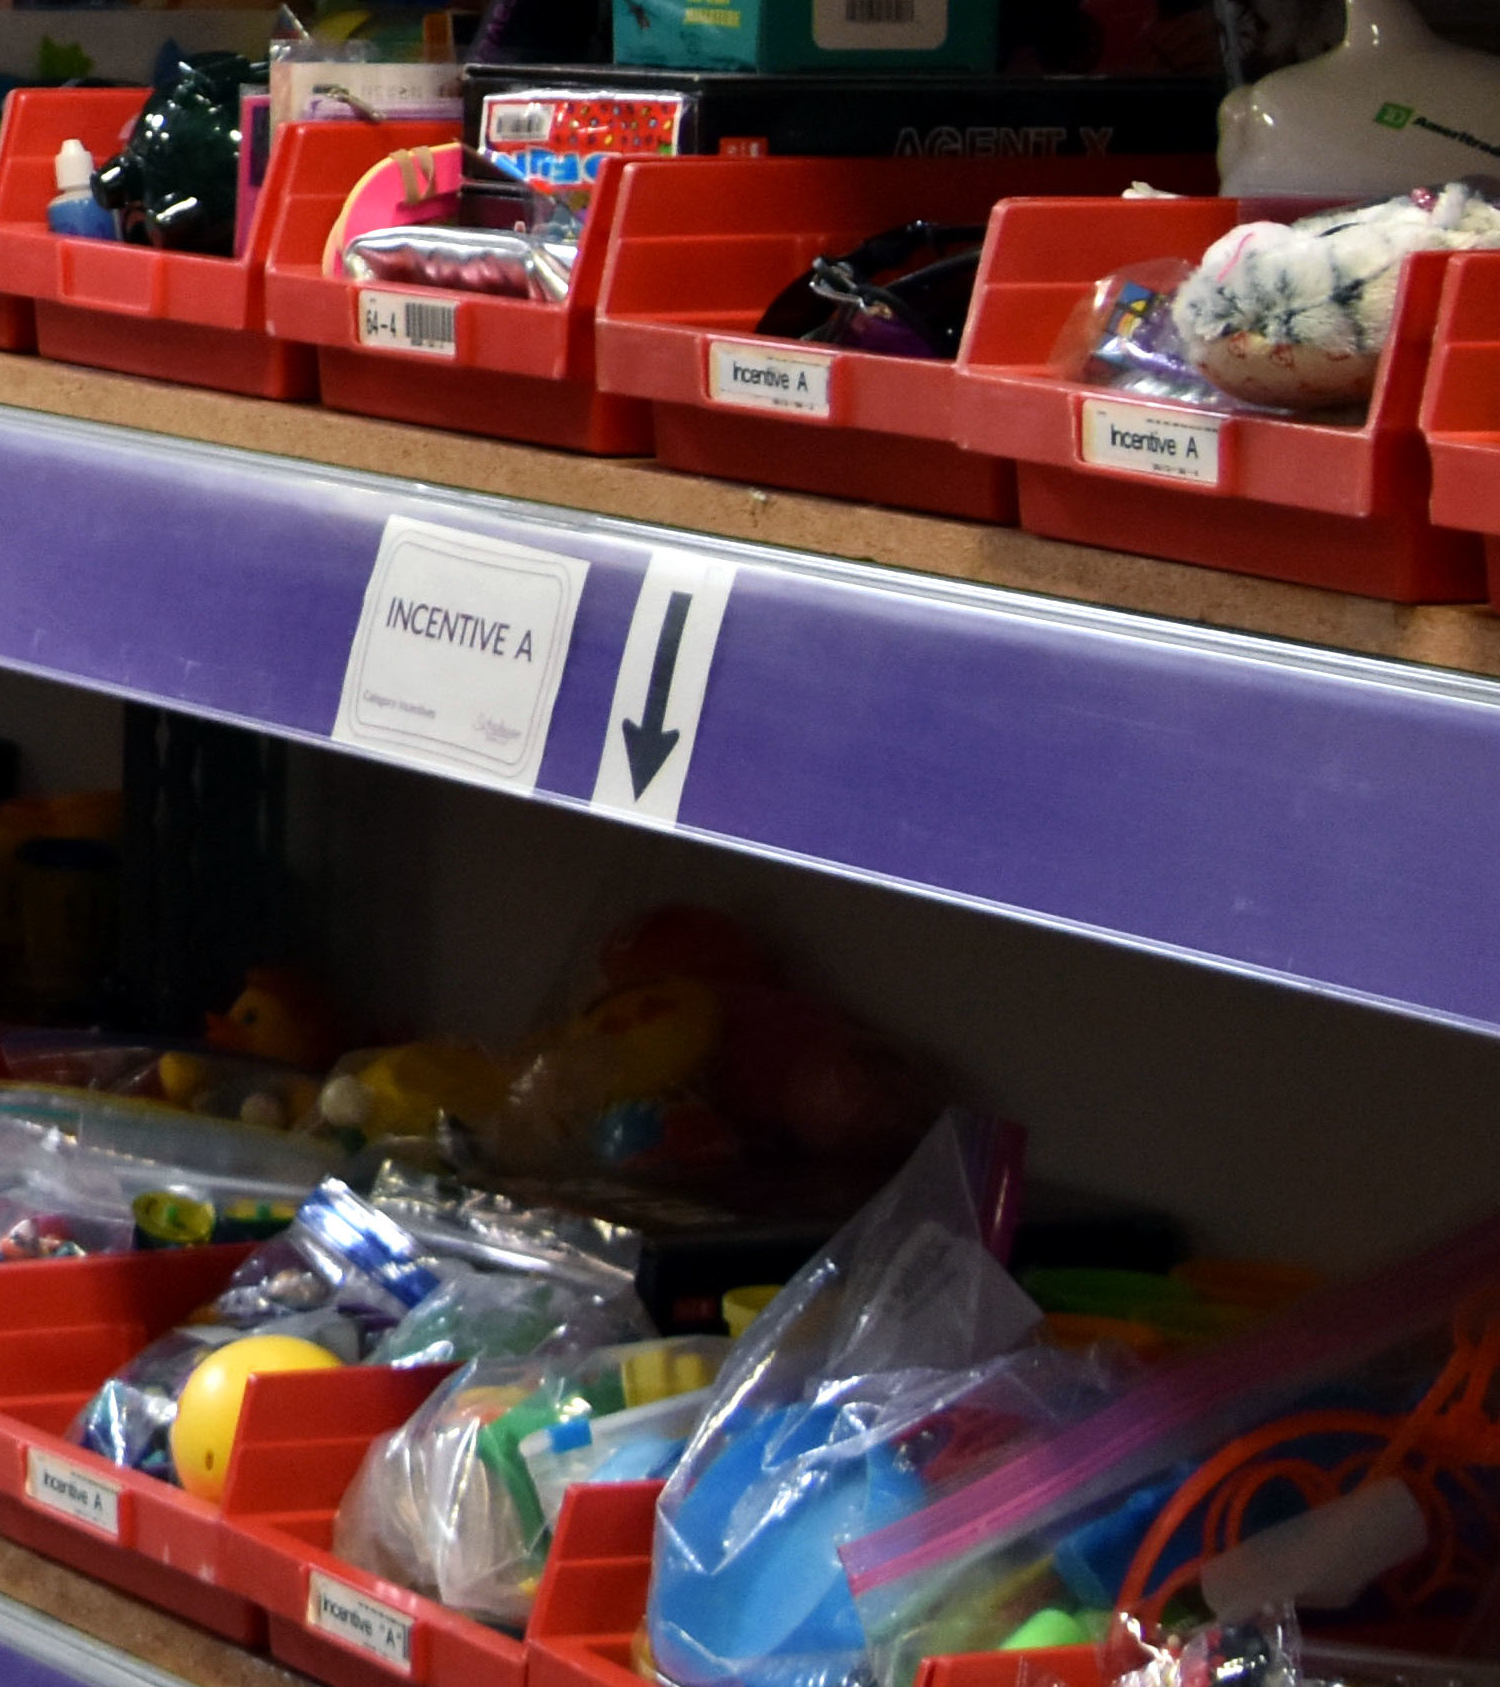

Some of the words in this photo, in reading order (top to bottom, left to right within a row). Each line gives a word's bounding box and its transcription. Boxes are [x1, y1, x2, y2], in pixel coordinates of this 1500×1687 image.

[732, 359, 790, 390] Incentive
[797, 371, 809, 392] A
[1110, 422, 1176, 456] Incentive
[1186, 435, 1199, 459] A
[385, 596, 511, 657] INCENTIVE
[514, 629, 533, 663] A
[93, 1492, 104, 1512] A
